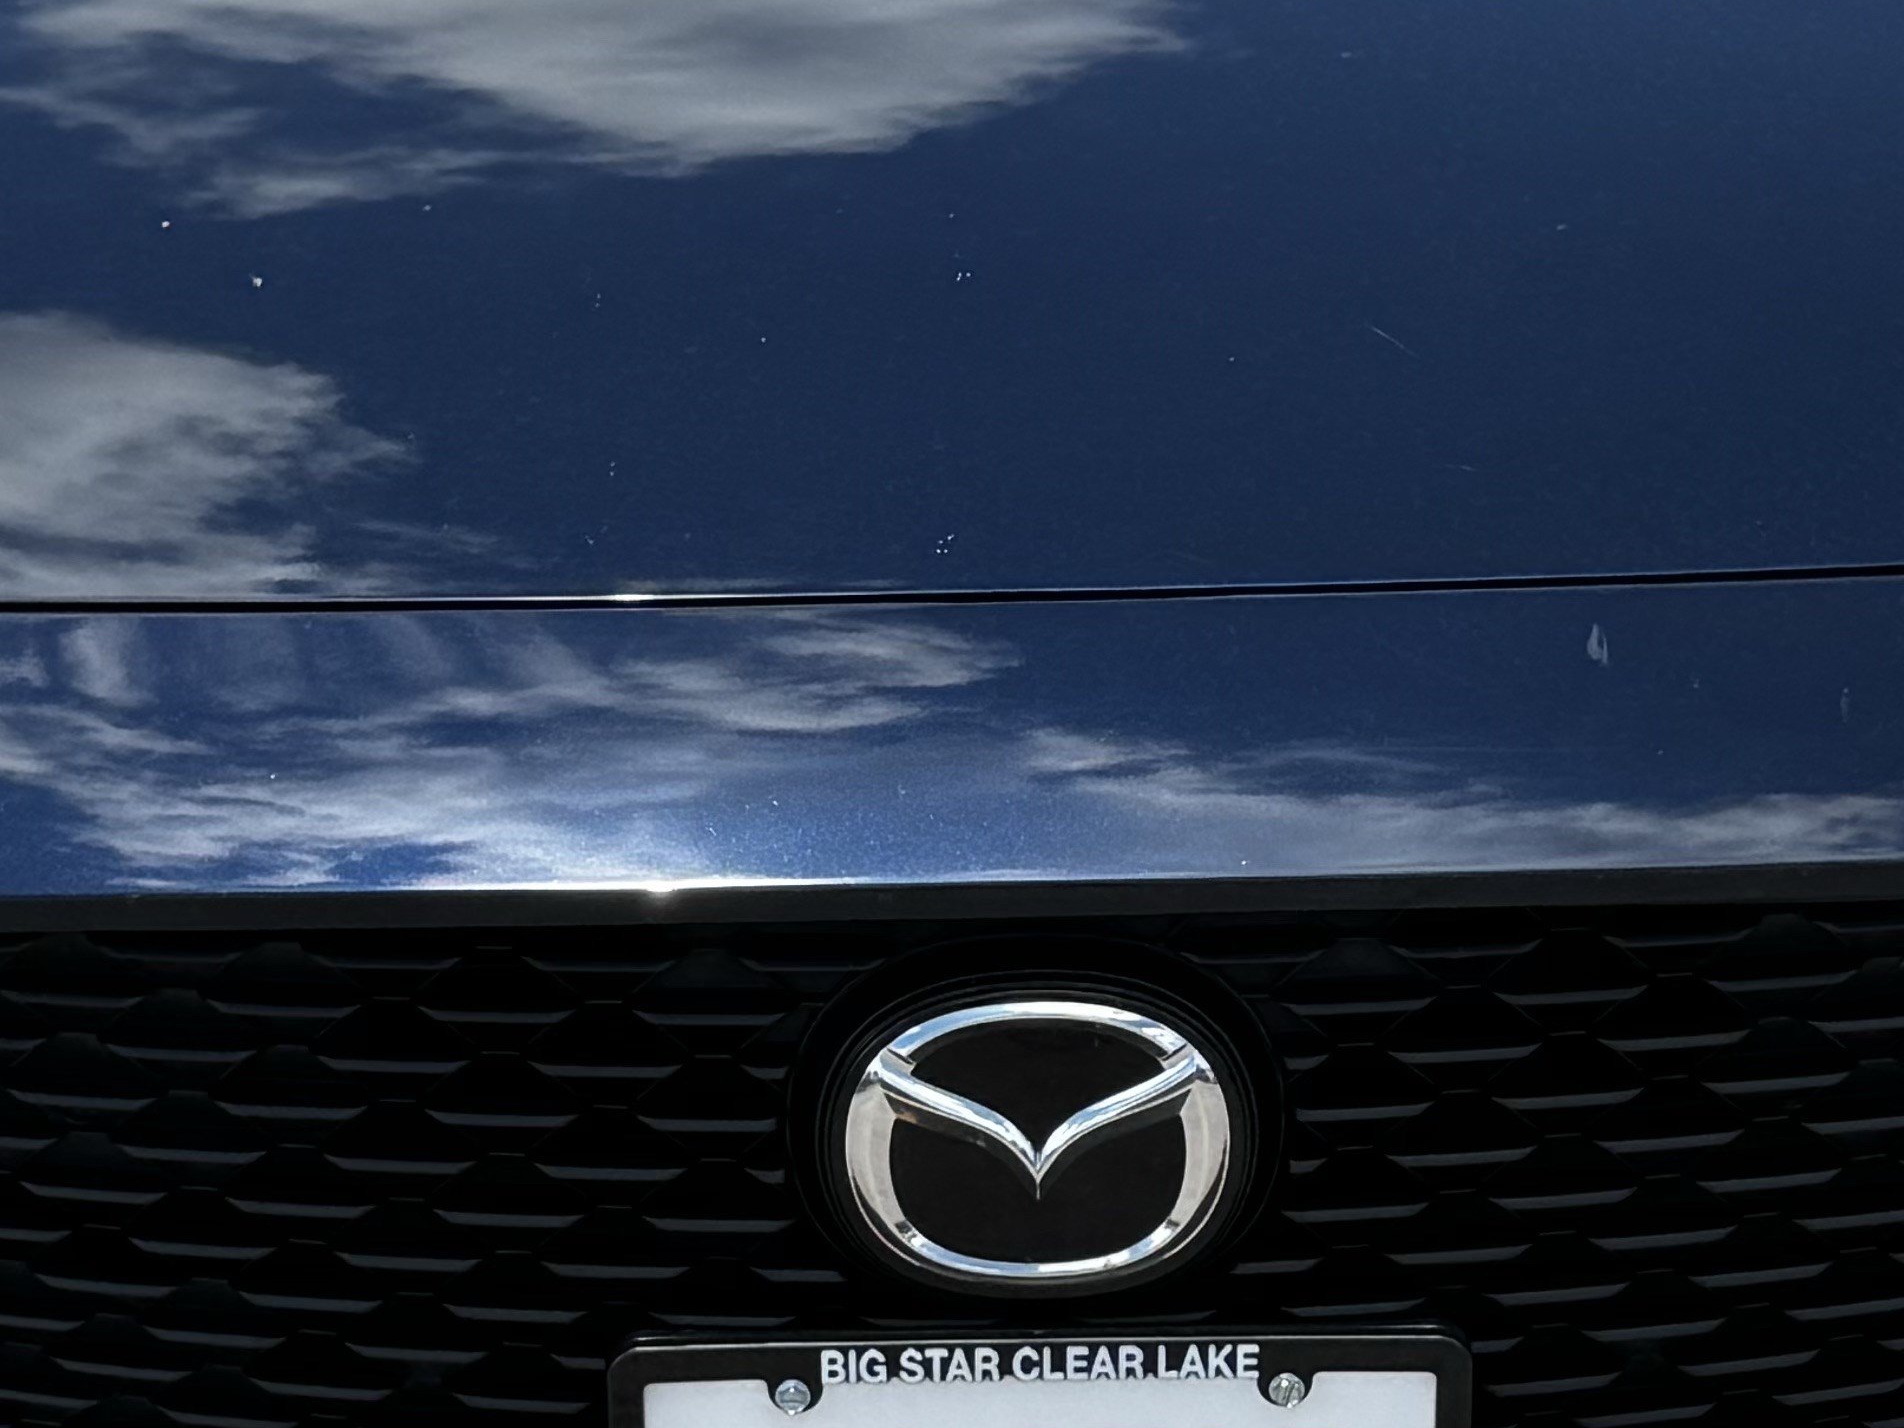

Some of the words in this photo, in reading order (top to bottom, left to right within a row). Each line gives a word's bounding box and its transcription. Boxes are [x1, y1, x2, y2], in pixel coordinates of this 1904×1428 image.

[820, 1349, 888, 1384] BIG
[899, 1346, 1000, 1384] STAR
[1012, 1344, 1145, 1382] CLEAR
[1157, 1343, 1260, 1380] LAKE
